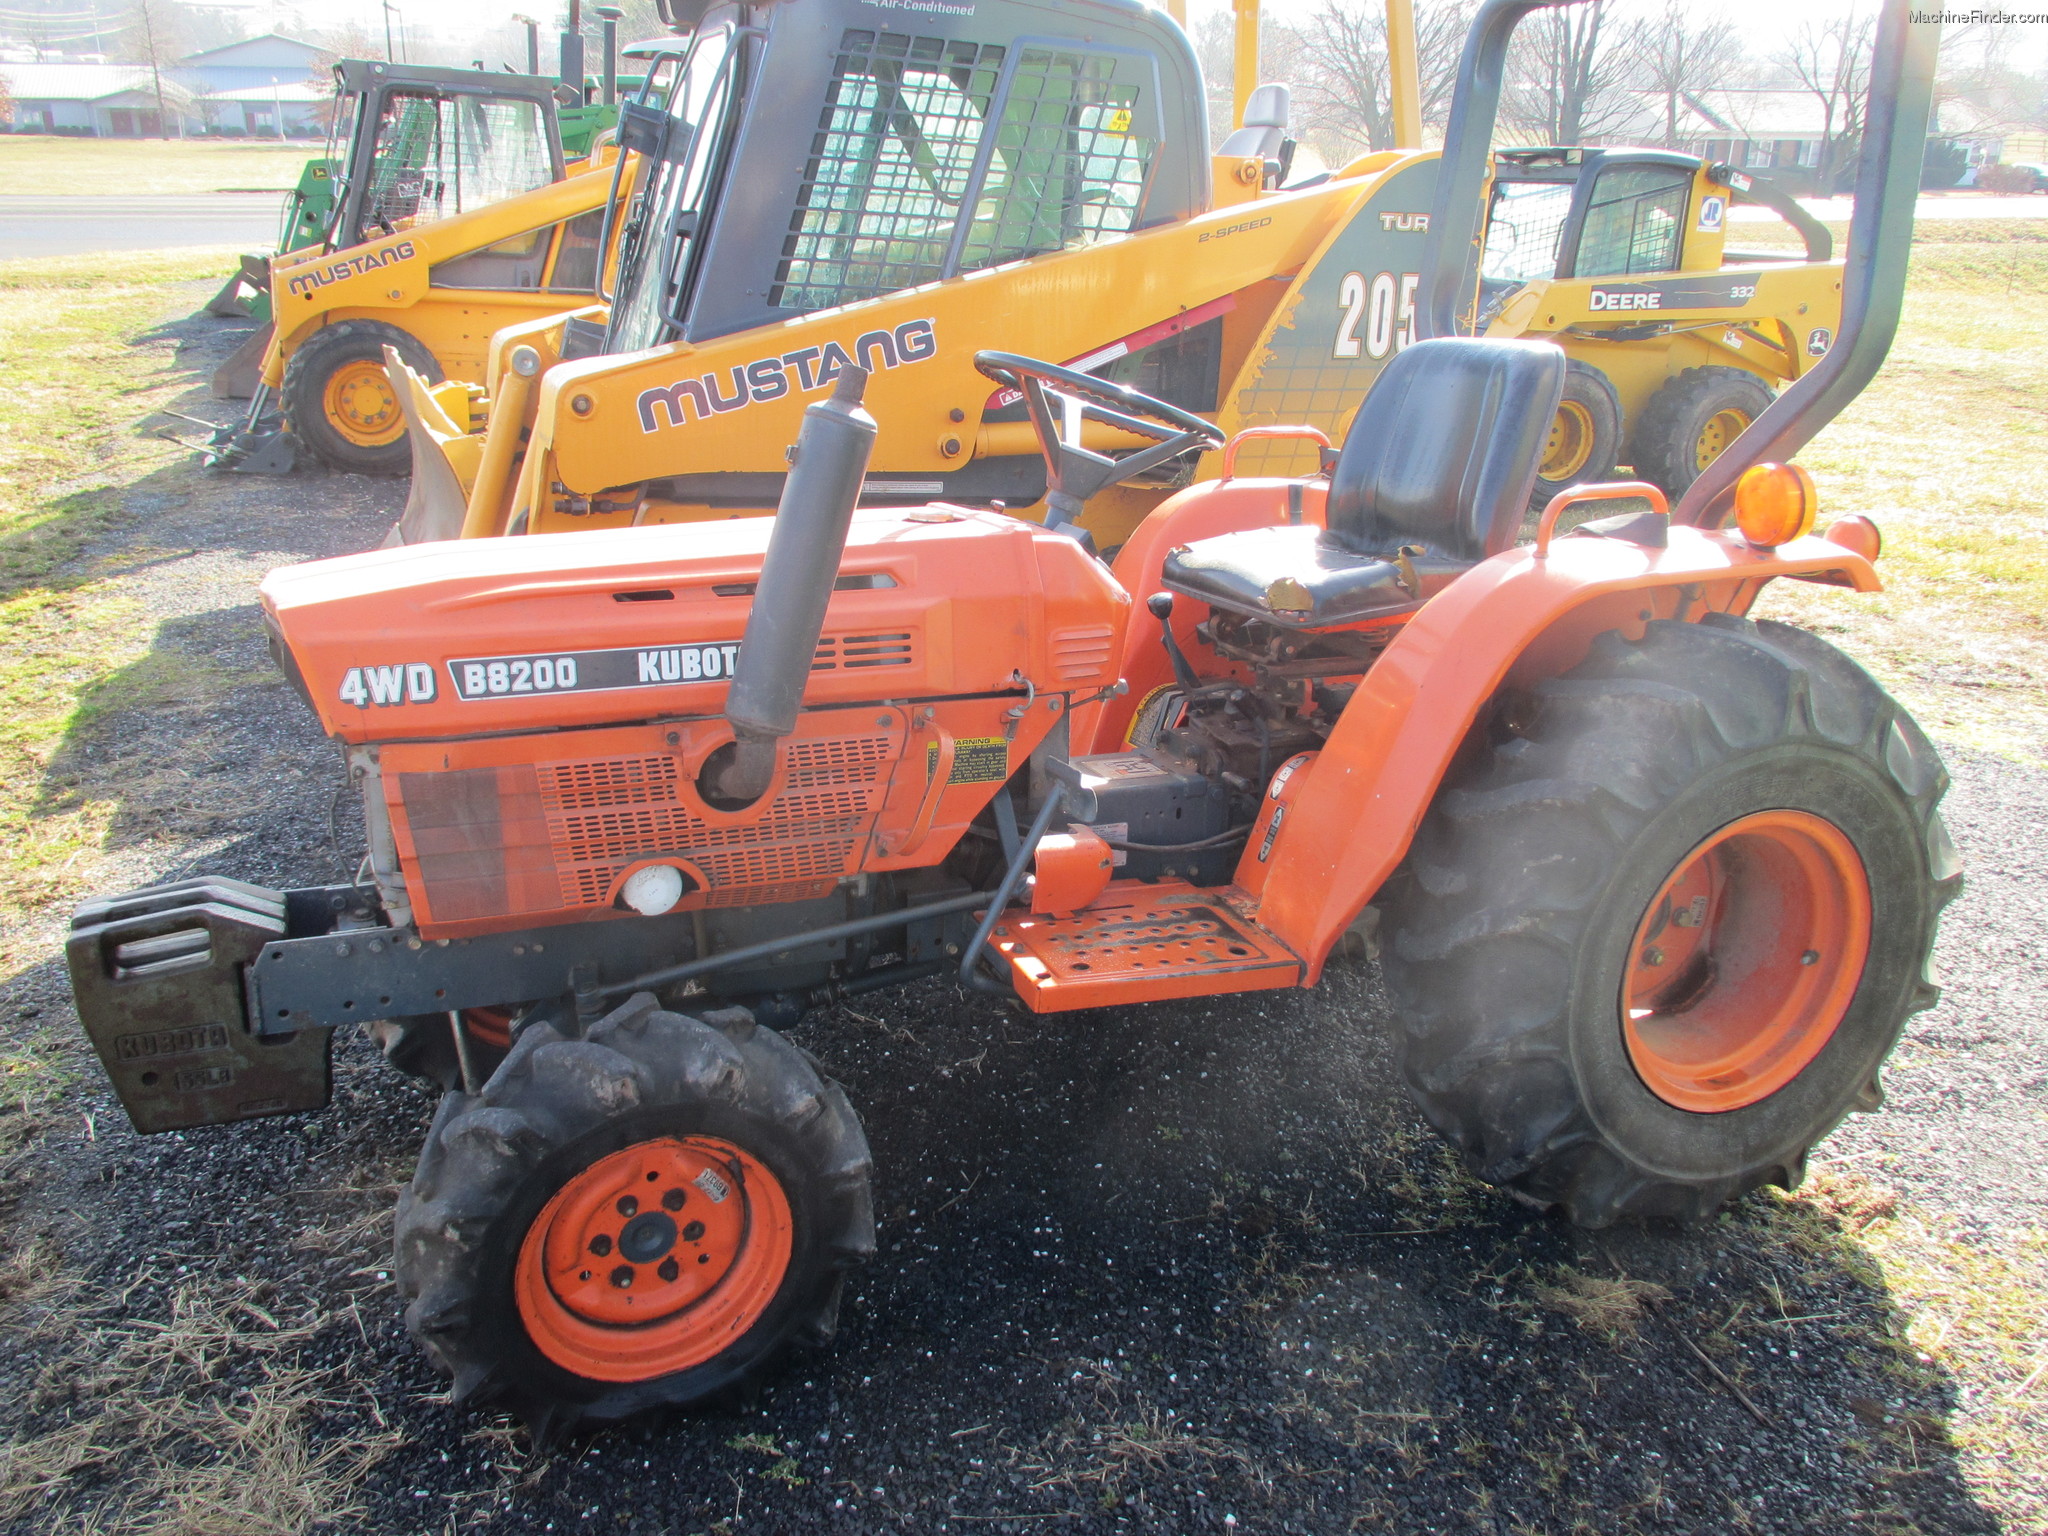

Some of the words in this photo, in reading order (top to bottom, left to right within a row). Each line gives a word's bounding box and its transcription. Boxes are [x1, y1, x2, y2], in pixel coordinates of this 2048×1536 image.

[880, 0, 975, 16] Air-Conditioned
[1199, 216, 1272, 243] 2-SPEED
[288, 240, 416, 296] MUSTANG
[1590, 290, 1661, 311] DEERE
[1730, 286, 1755, 299] 332
[637, 319, 937, 433] MUSTANG
[339, 663, 438, 708] 4WD
[464, 657, 578, 695] B8200
[638, 645, 741, 682] KUBOT
[954, 737, 991, 746] ARNING
